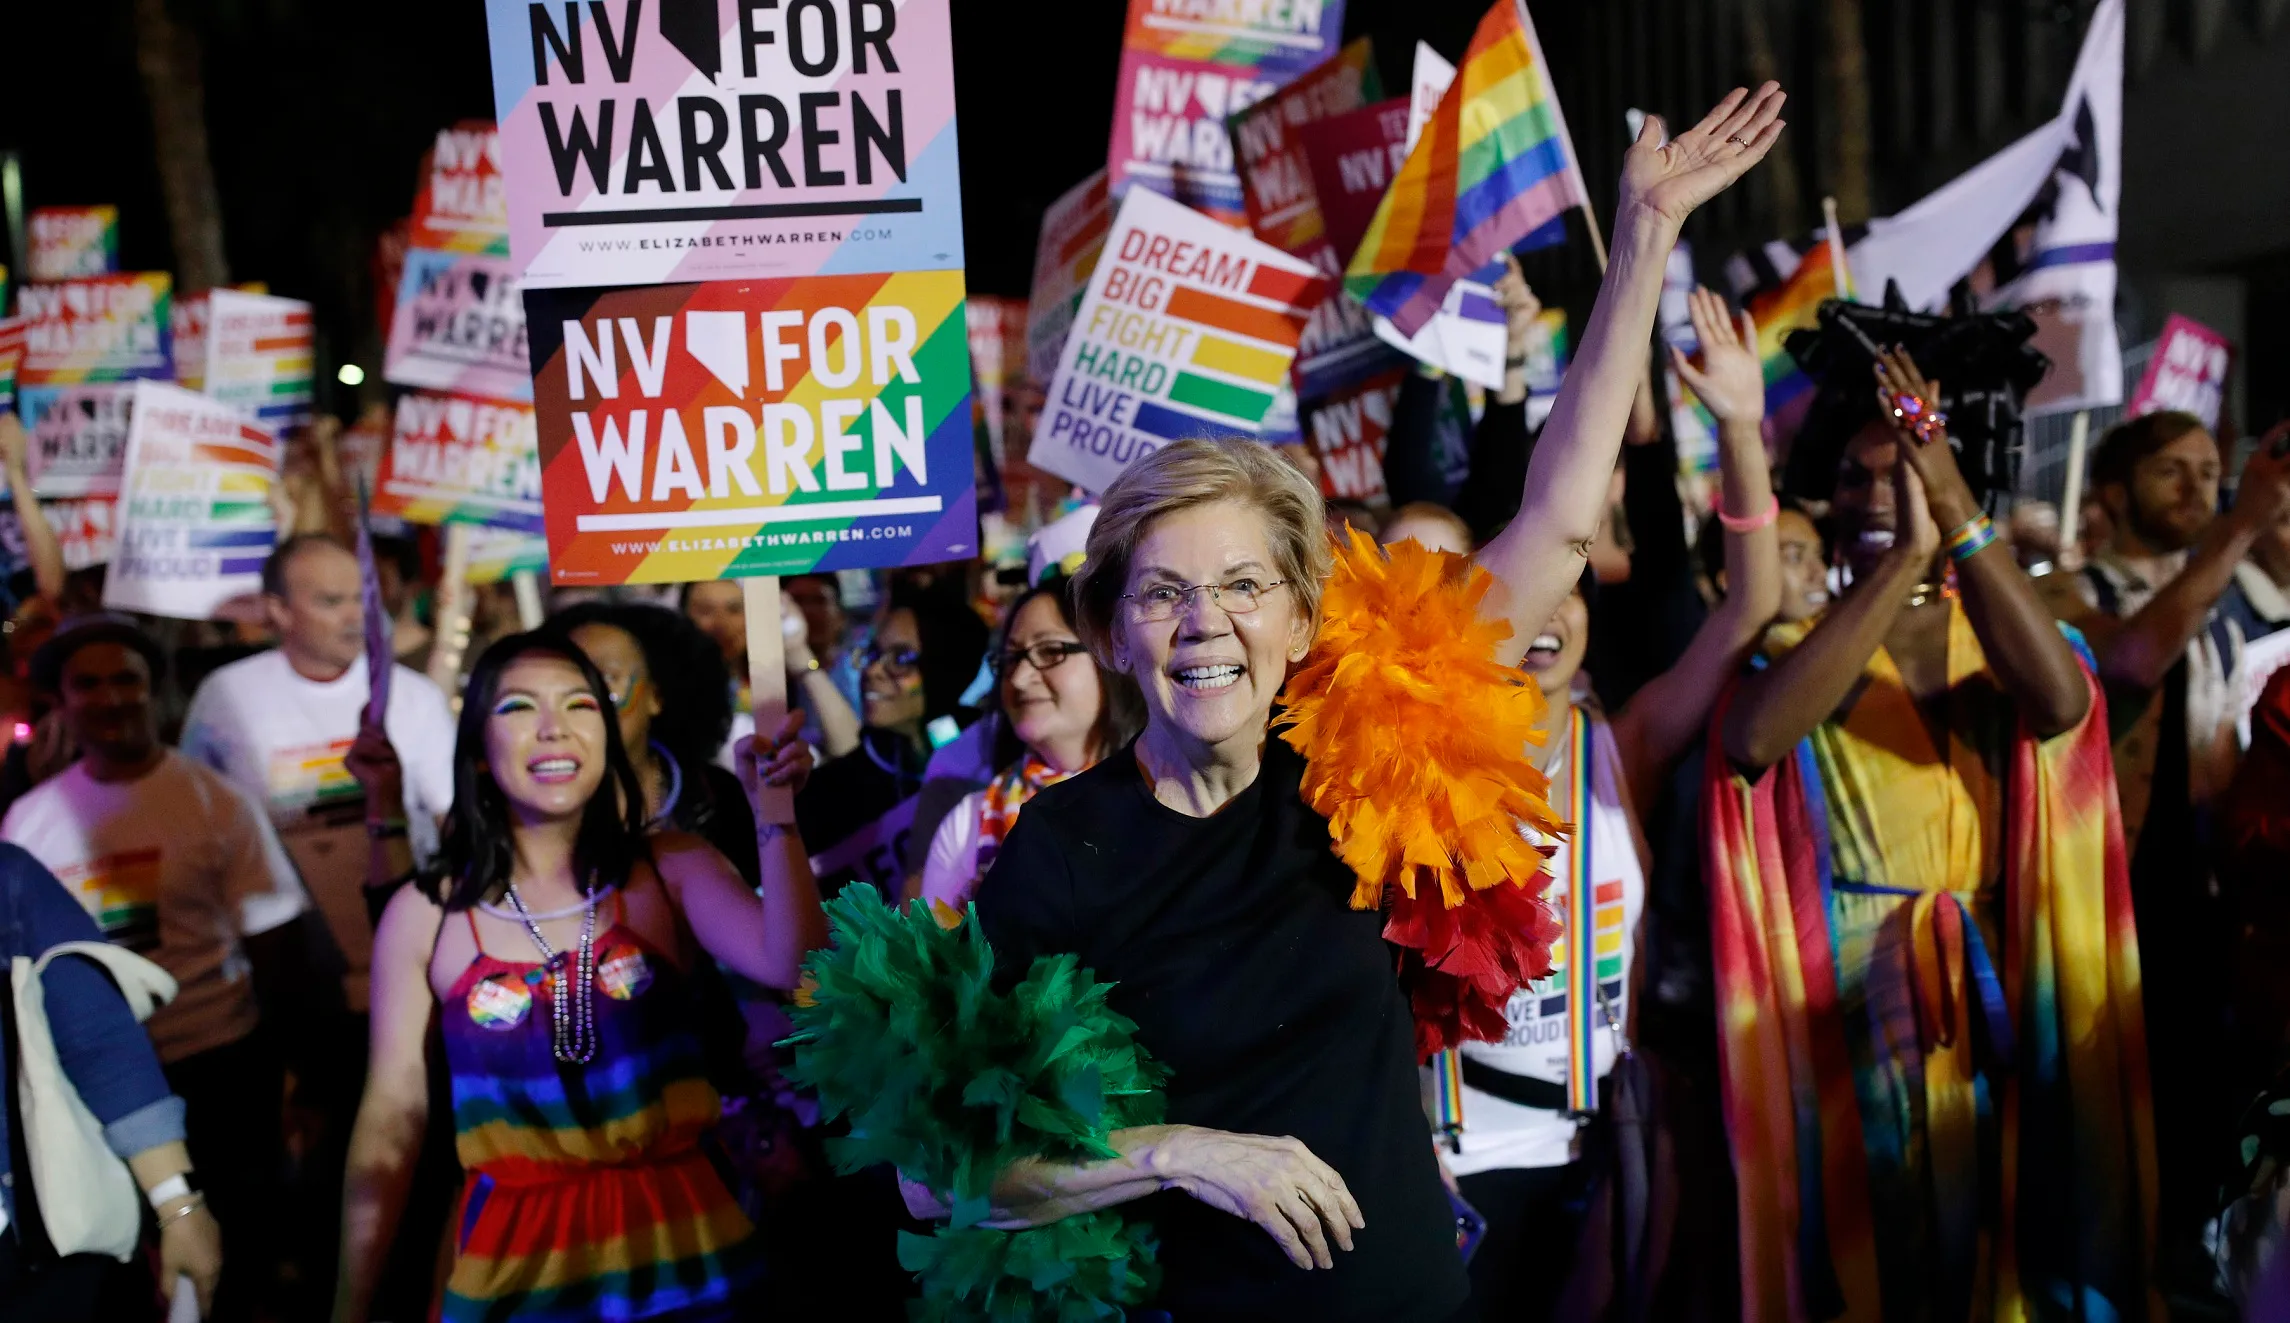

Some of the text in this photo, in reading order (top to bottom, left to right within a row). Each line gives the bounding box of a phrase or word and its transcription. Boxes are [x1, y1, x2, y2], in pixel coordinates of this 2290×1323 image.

[529, 0, 901, 86] NV FOR
[1133, 66, 1195, 115] NV
[537, 89, 907, 197] WARREN
[1132, 111, 1236, 172] WAR
[579, 228, 894, 252] WWW.ELIZABETHWARREN.COM
[1118, 227, 1249, 292] DREAM
[1103, 266, 1165, 310] BIG
[562, 315, 673, 400] NV
[760, 305, 922, 392] FOR
[1087, 304, 1194, 361] FIGHT
[1074, 341, 1168, 396] HARD
[1062, 376, 1133, 425] LIVE
[570, 395, 928, 504] WARREN
[611, 525, 913, 556] WWW.ELIZABETHWARREN.COM
[1503, 1020, 1560, 1046] ROUD
[1505, 1001, 1534, 1022] IVE
